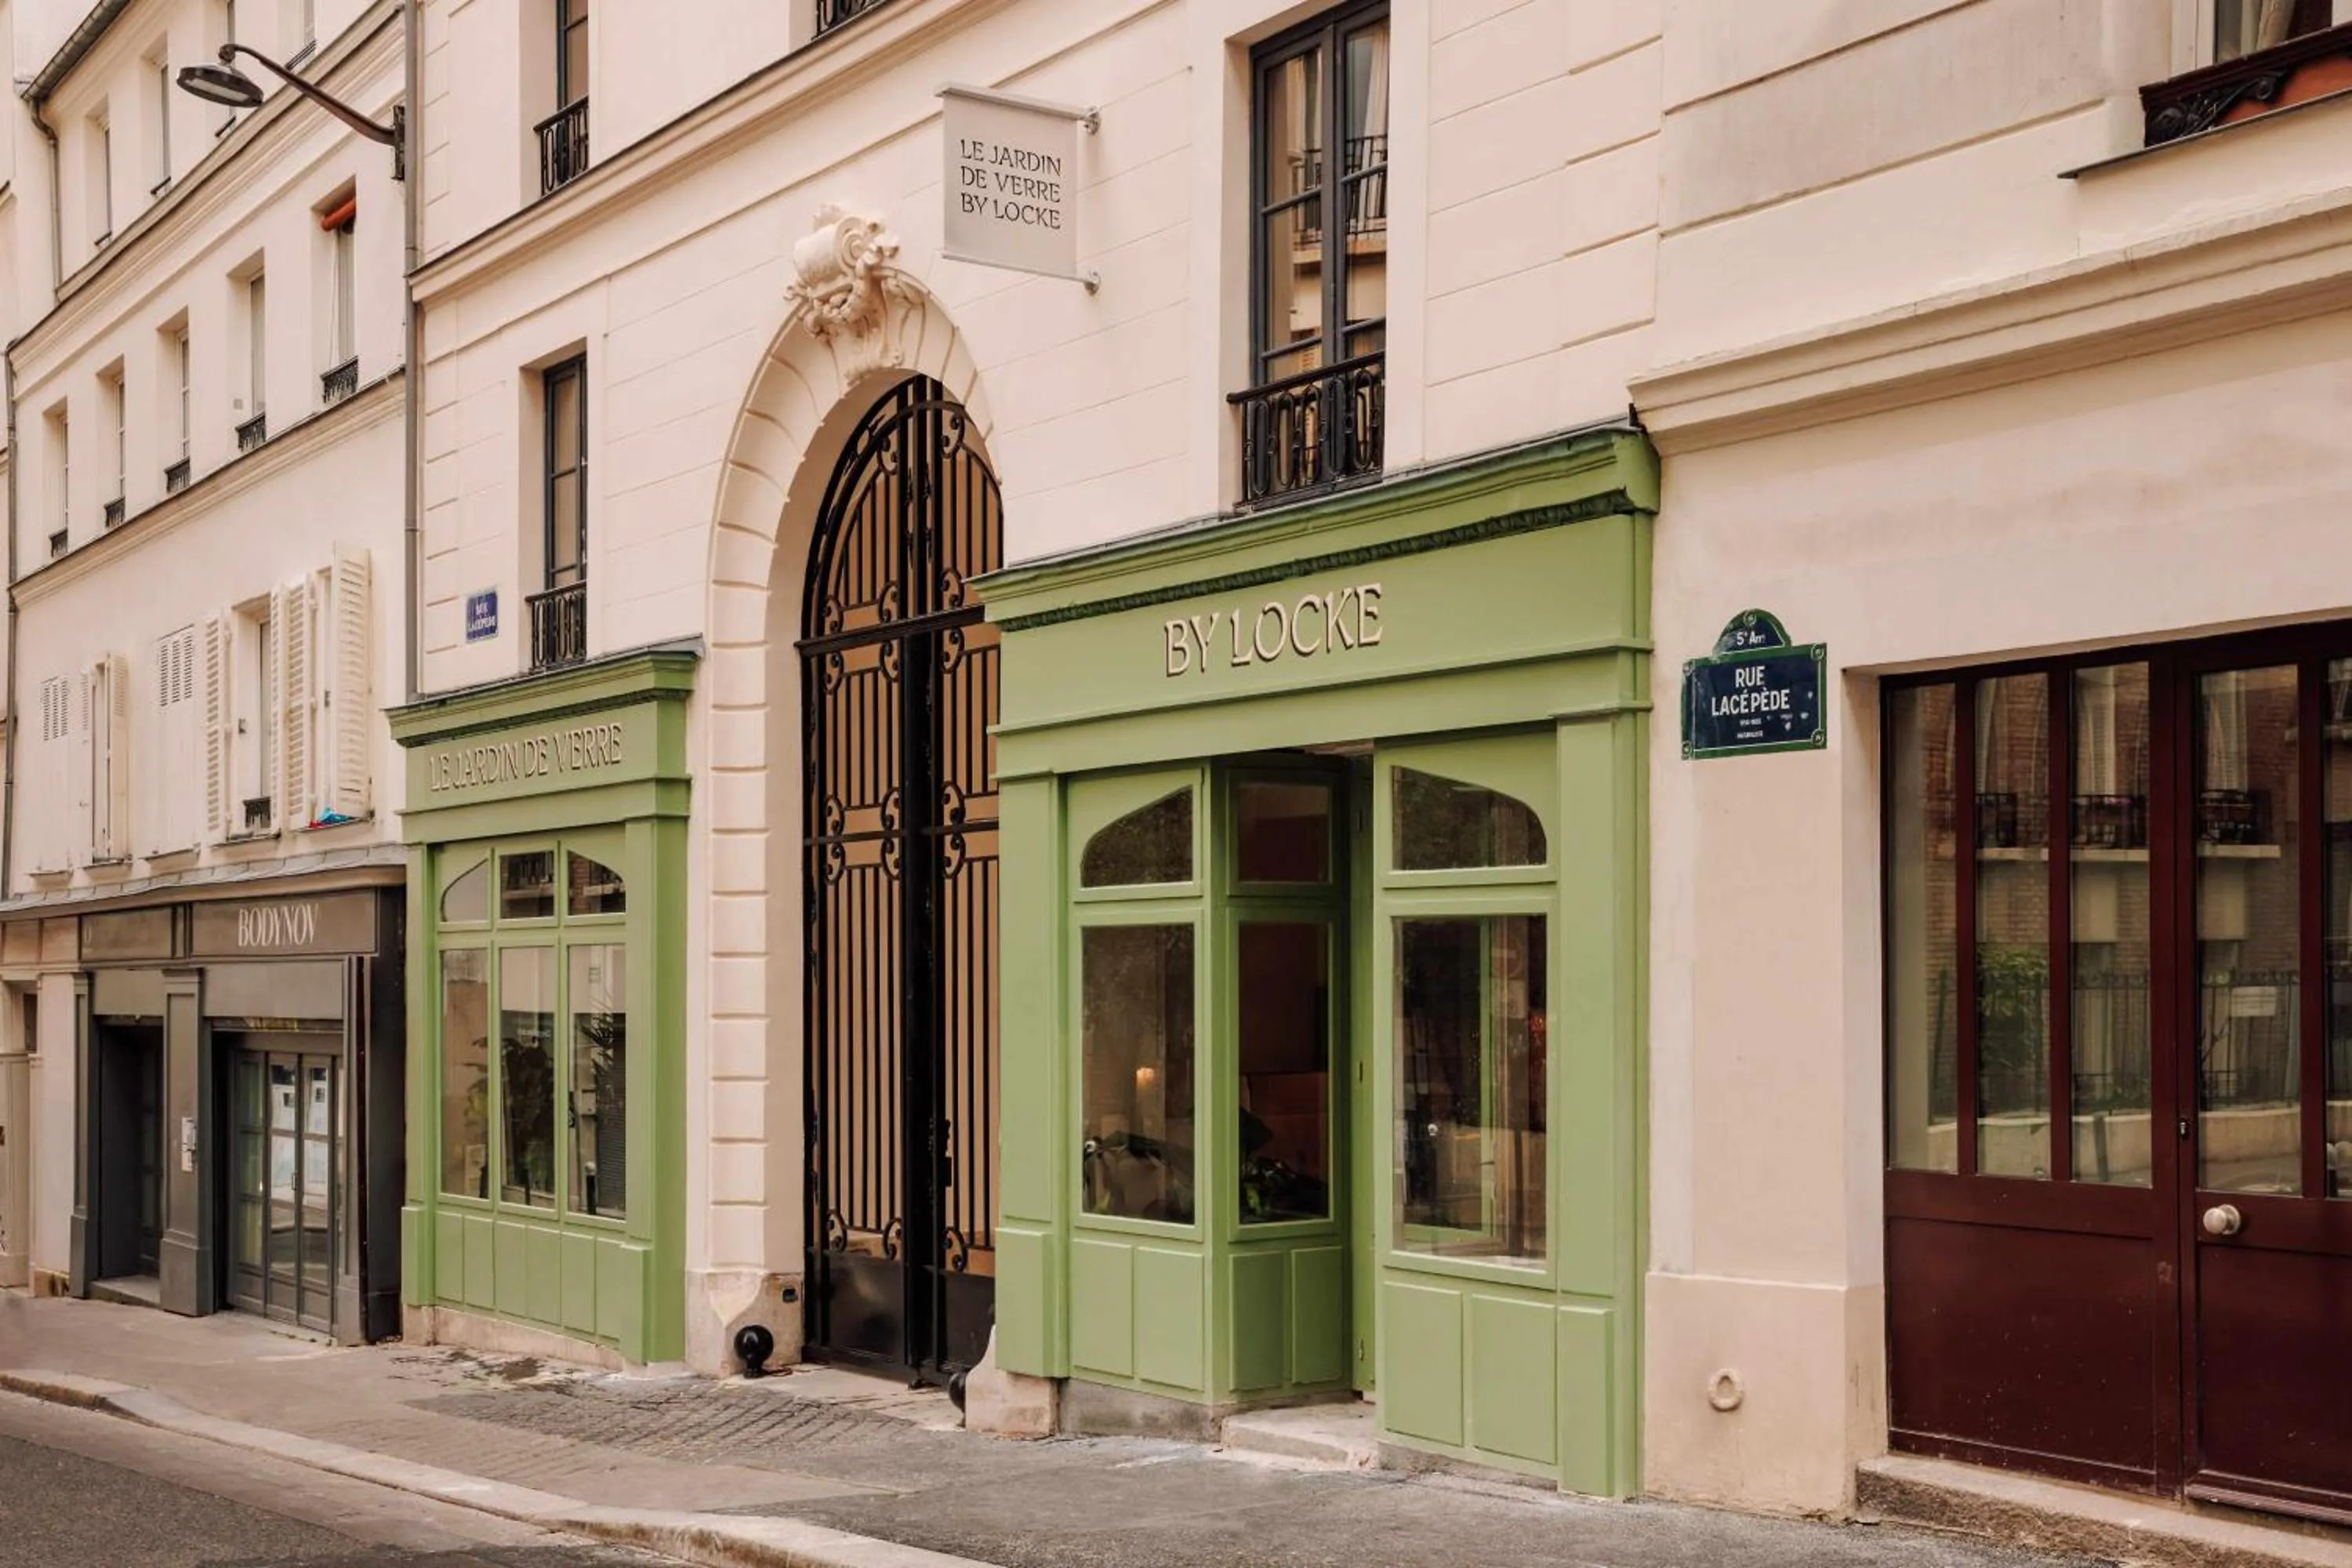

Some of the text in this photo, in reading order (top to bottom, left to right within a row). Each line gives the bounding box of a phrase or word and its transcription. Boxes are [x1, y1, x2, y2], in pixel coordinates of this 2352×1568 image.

[960, 139, 1061, 176] LE JARDIN
[961, 165, 1061, 203] DE VERRE
[961, 192, 1061, 230] BY LOCKE
[1164, 583, 1383, 677] BY LOCKE
[1735, 666, 1766, 688] RUE
[1711, 687, 1790, 717] LACÉPÈDE
[430, 722, 622, 792] LE JARDIN DE VERRE
[238, 903, 319, 946] BODYNOV
